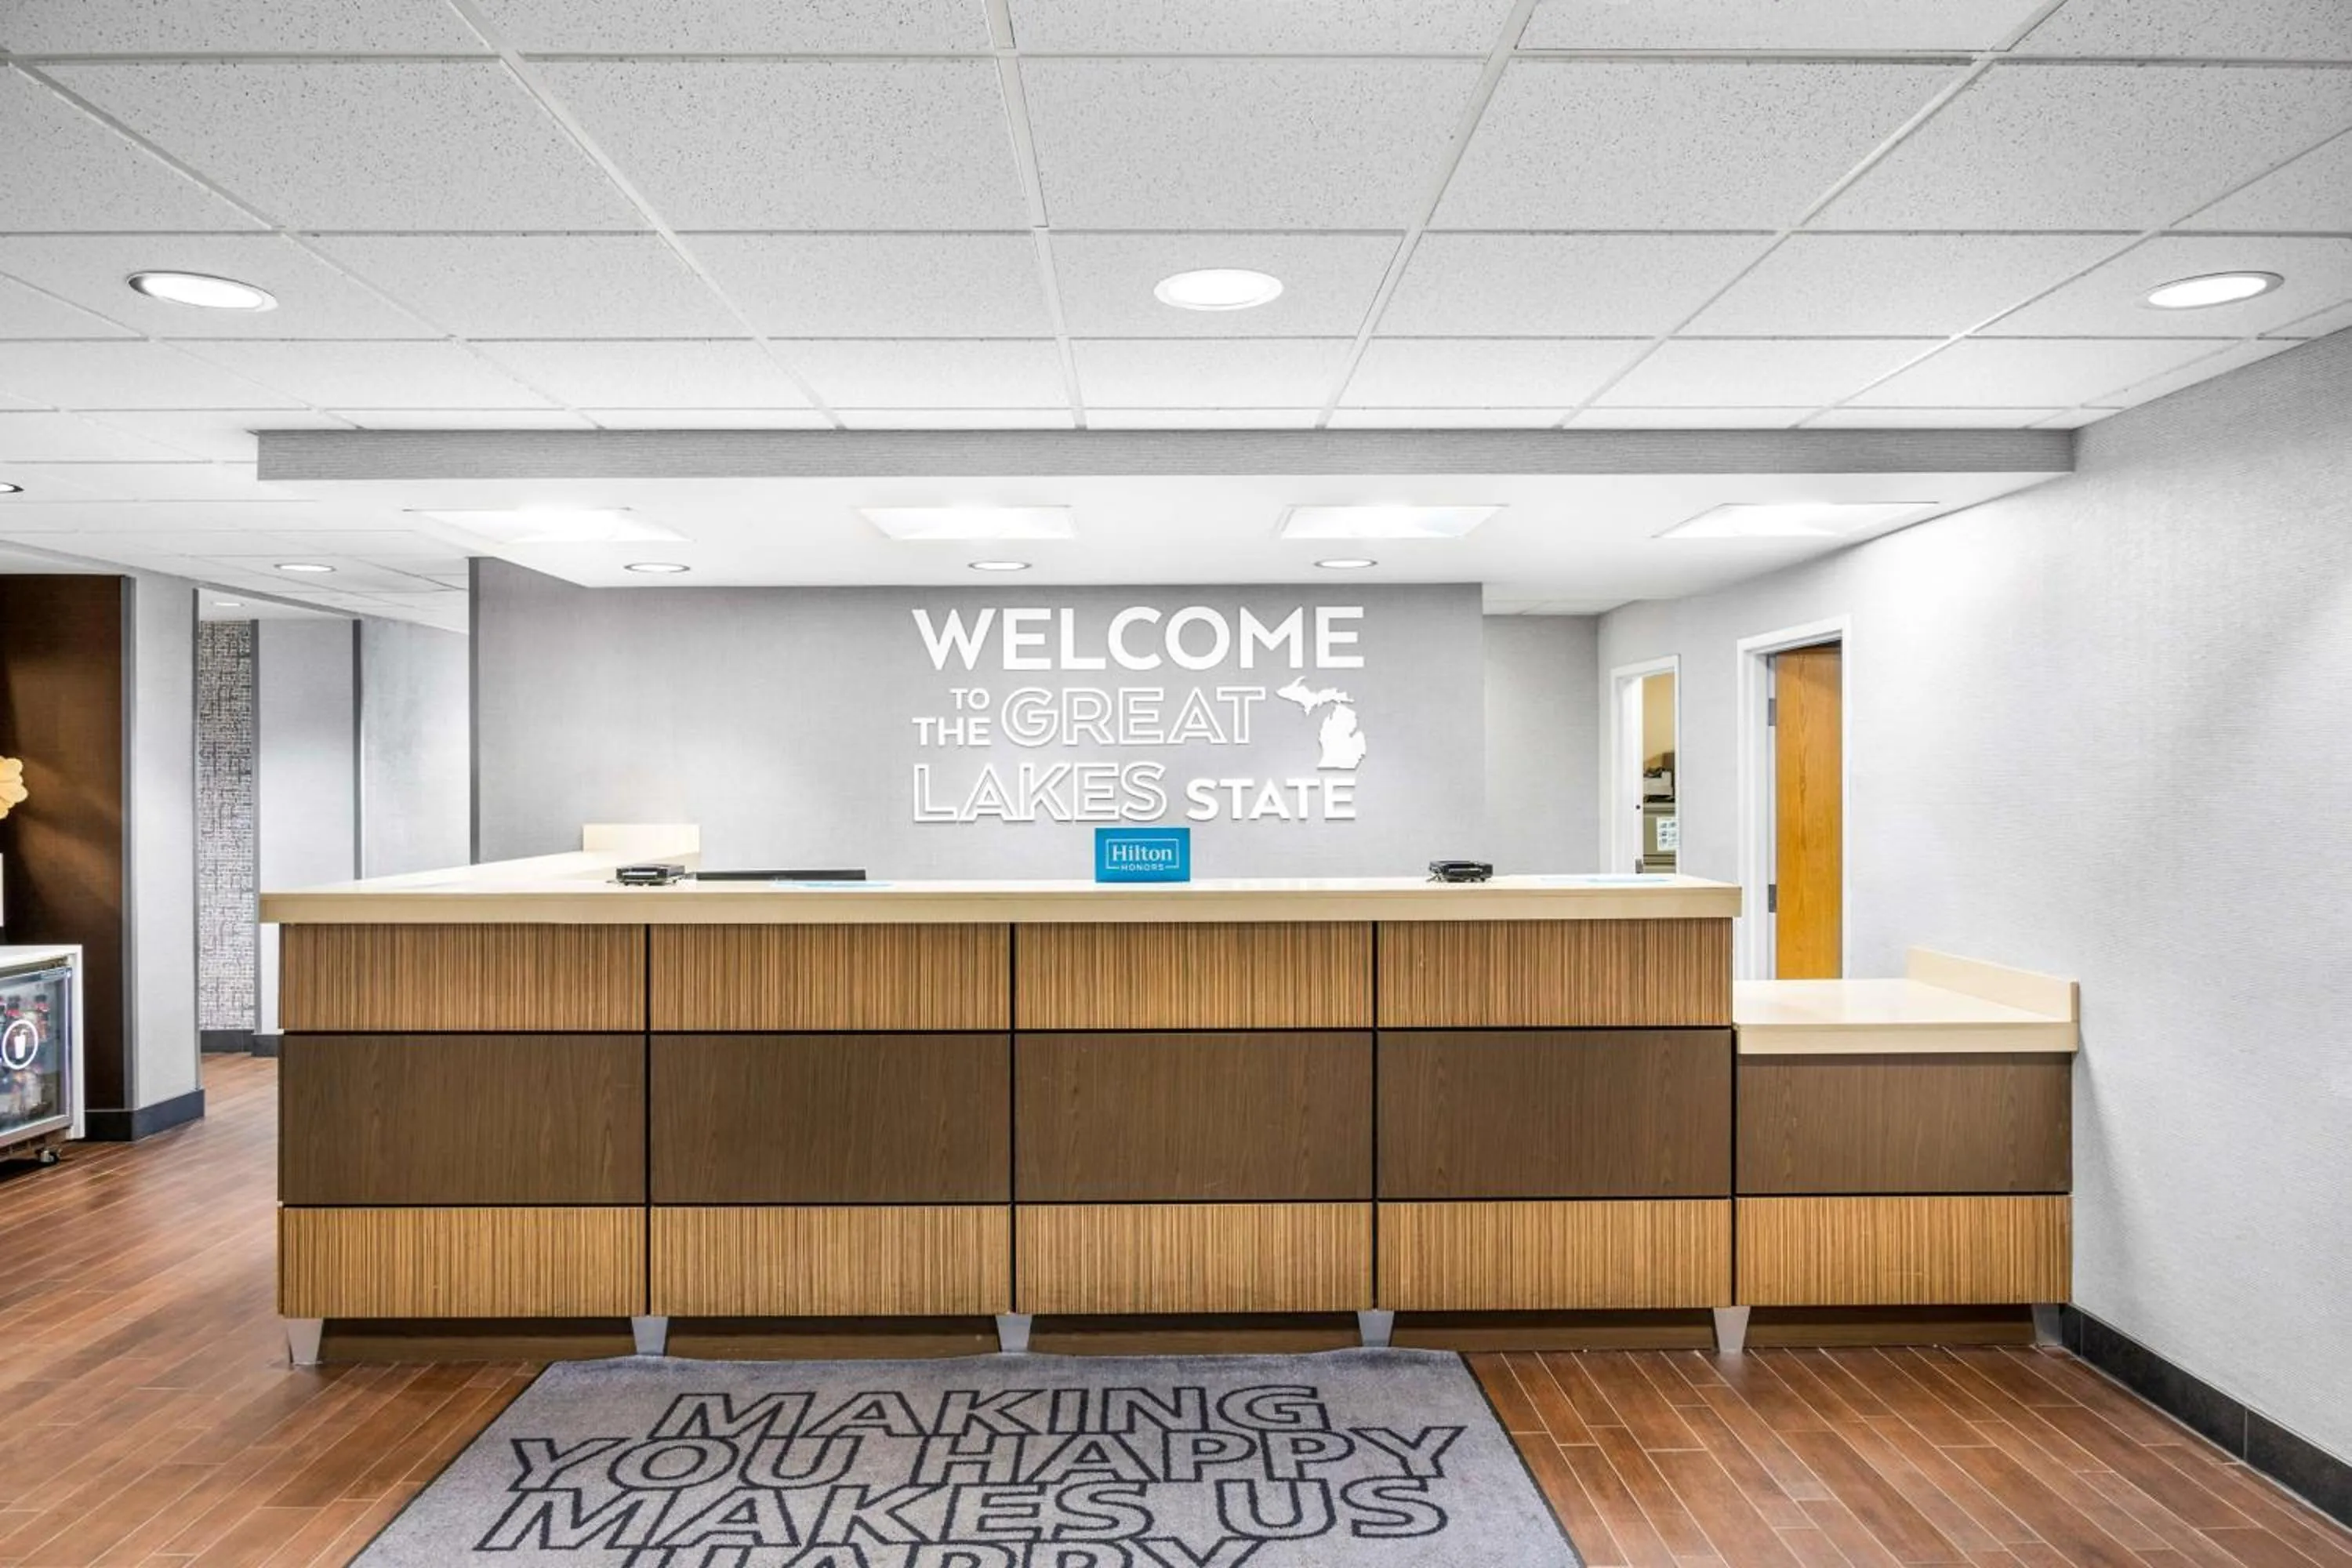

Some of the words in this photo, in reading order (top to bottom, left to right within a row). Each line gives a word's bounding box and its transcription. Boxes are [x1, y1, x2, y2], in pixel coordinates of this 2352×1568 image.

[912, 606, 1364, 670] WELCOME
[912, 717, 992, 746] THE
[1000, 686, 1266, 746] GREAT
[950, 688, 990, 710] TO
[912, 761, 1167, 822] LAKES
[1185, 778, 1357, 821] STATE
[1112, 844, 1172, 862] Hilton
[648, 1385, 1331, 1440] MAKING
[507, 1434, 863, 1491] YOU
[909, 1425, 1468, 1486] HAPPY
[473, 1480, 1154, 1551] MAKES
[1215, 1475, 1448, 1541] US
